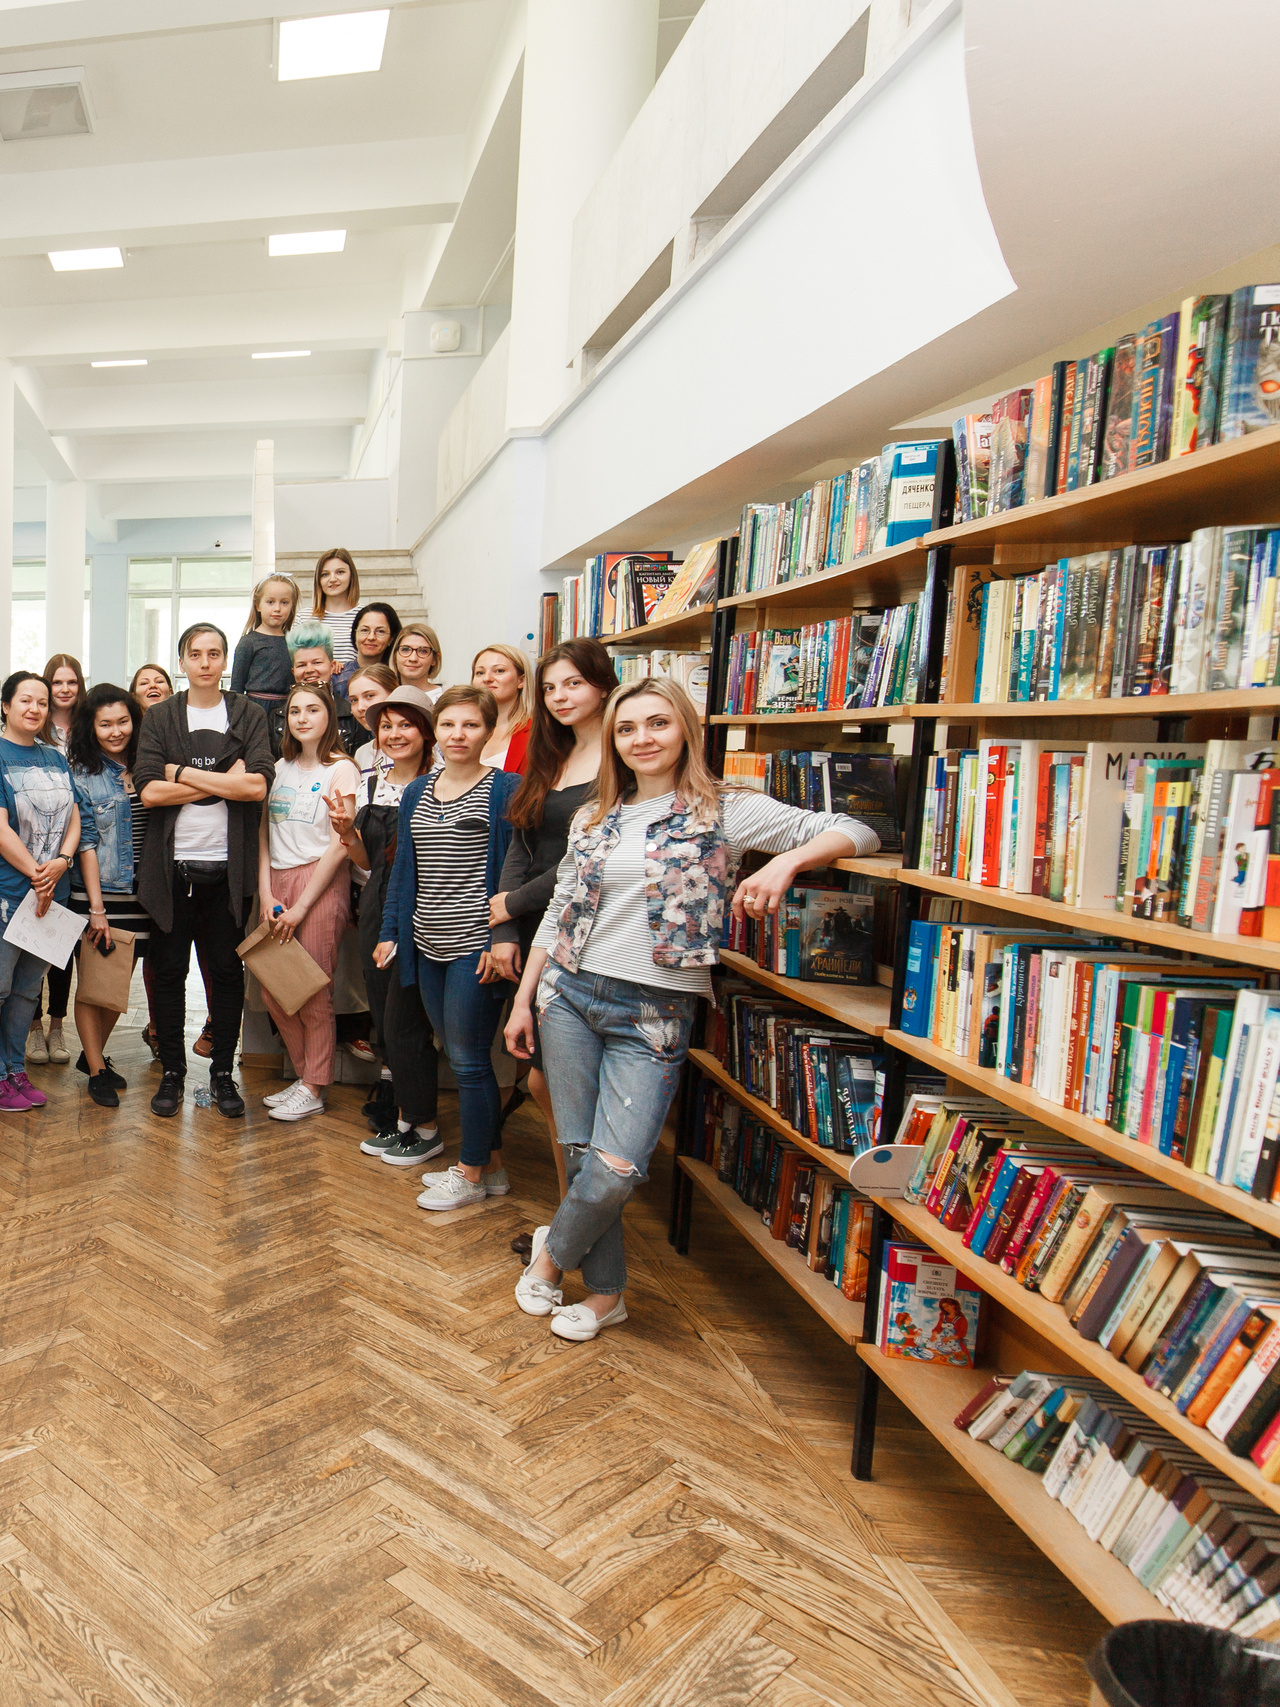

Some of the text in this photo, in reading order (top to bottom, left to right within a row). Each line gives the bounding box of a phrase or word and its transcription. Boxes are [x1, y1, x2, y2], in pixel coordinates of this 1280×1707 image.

[902, 483, 935, 495] ДЯЧЕНКО
[857, 486, 865, 517] ЗАХВАТА
[904, 501, 931, 510] ПЕЩЕРА
[636, 574, 666, 584] НОВЫЙ
[810, 956, 862, 974] ХРАНИТЕЛИ
[843, 1087, 858, 1146] АПТЕКАРЬ
